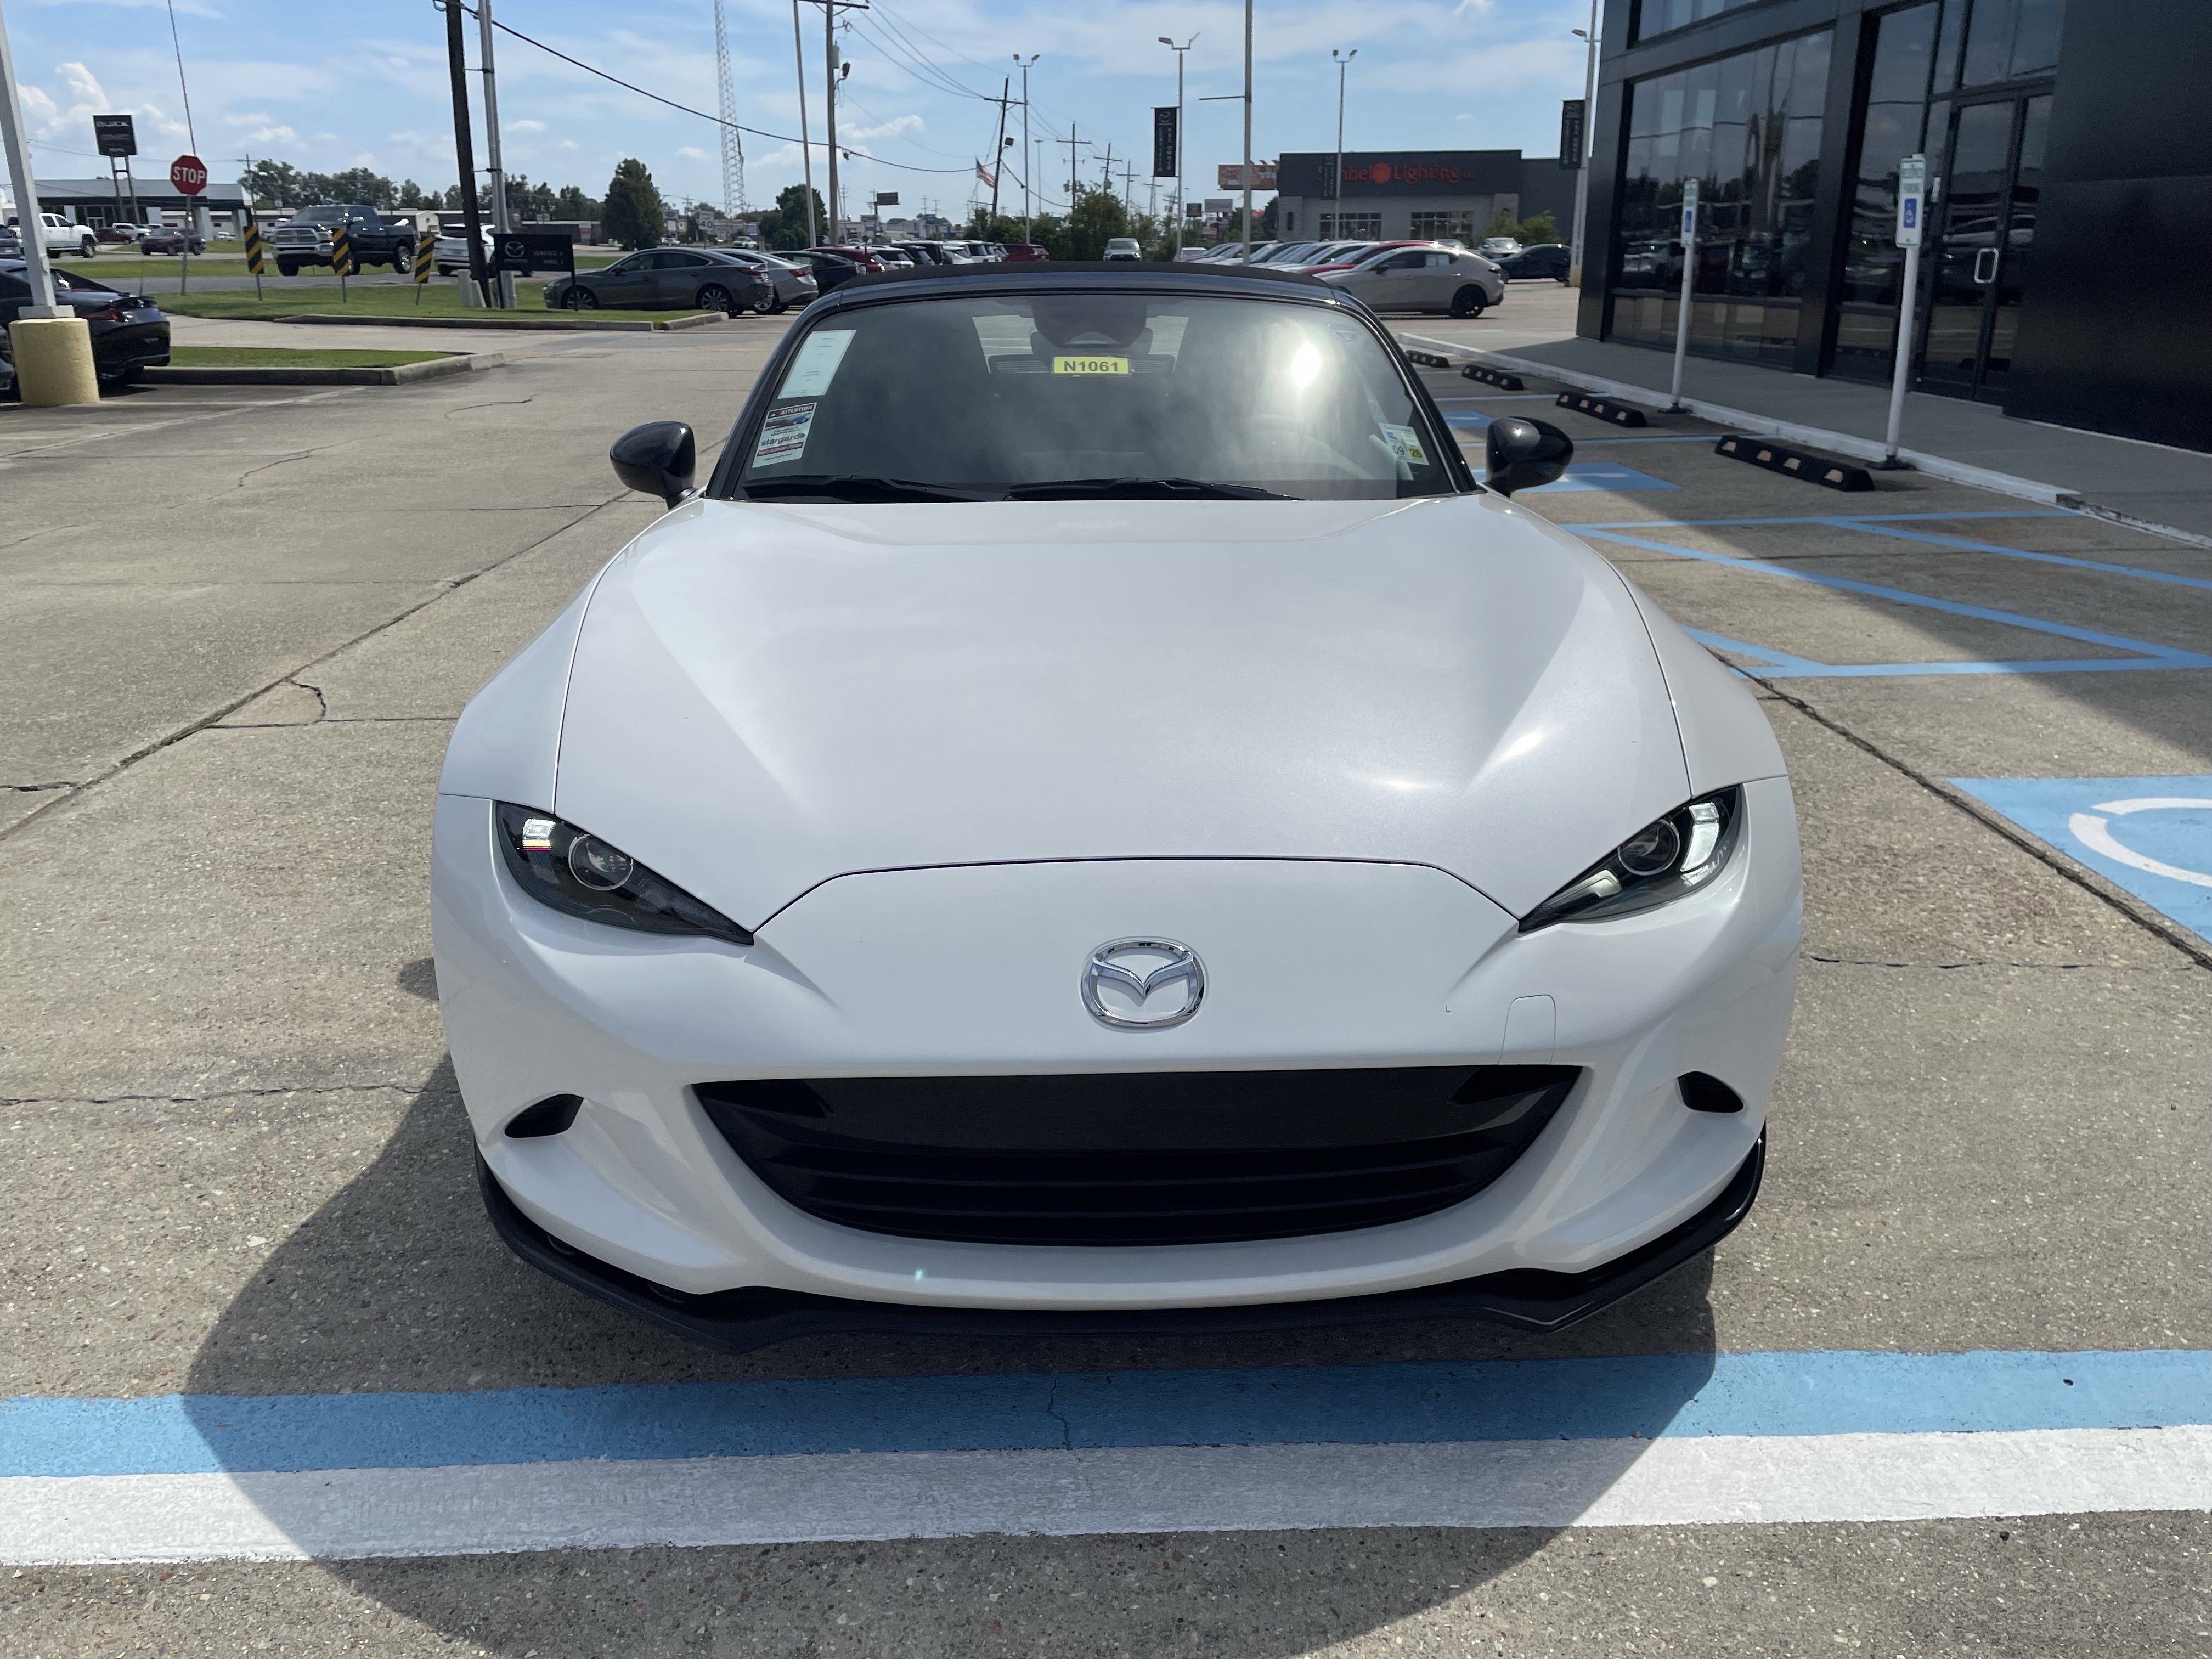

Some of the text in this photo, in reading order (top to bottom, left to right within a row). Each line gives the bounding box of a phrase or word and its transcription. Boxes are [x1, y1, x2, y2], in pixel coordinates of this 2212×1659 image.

[172, 166, 206, 184] STOP
[1393, 163, 1460, 184] Lighting
[700, 220, 713, 228] 40
[1064, 360, 1118, 372] N1061
[780, 405, 813, 415] ATTENTION
[1392, 445, 1422, 458] 09 26
